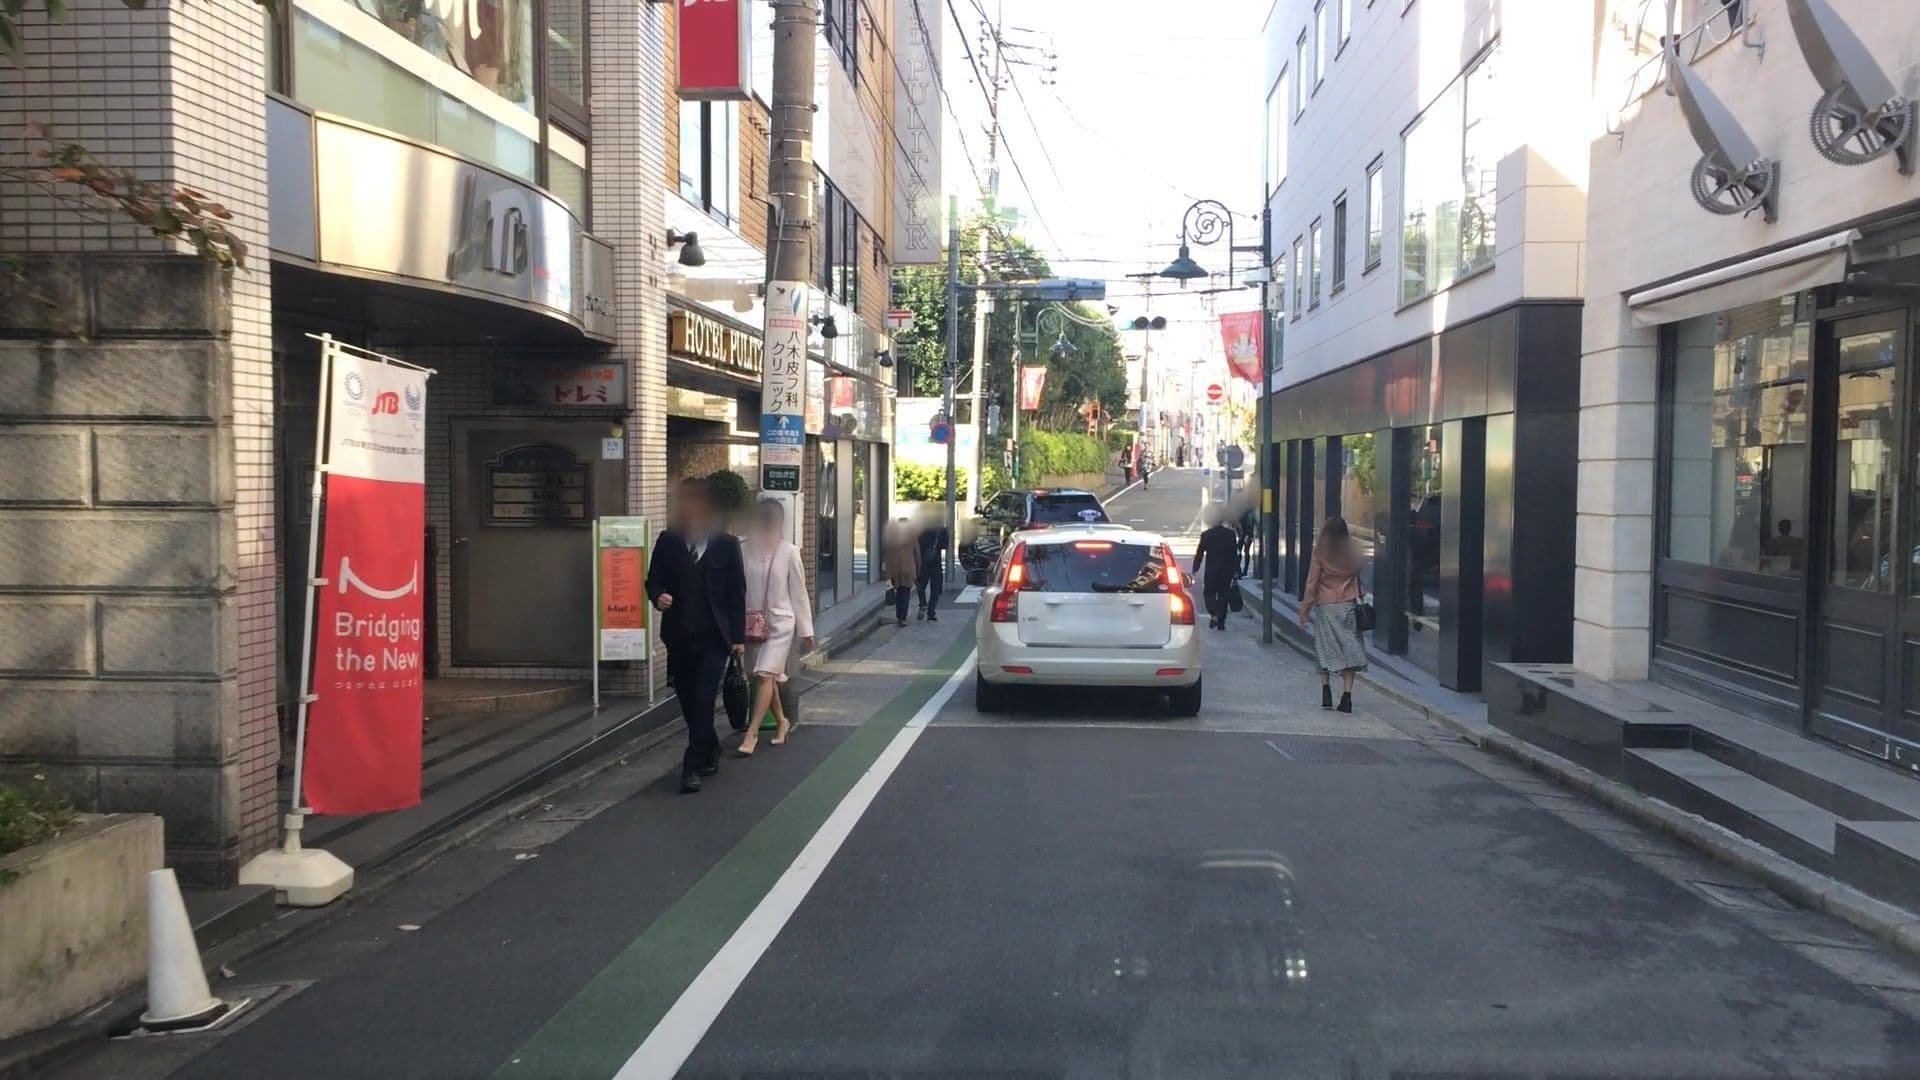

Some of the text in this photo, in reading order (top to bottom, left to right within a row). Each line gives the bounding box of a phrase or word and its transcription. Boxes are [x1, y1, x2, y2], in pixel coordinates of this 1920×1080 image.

[905, 59, 929, 251] PULITZER
[684, 310, 727, 363] HOTEL
[770, 341, 785, 412] クリニック
[785, 330, 801, 408] 八木皮フ科
[371, 391, 400, 415] JTB
[336, 611, 420, 643] Bridging
[336, 647, 419, 671] the New
